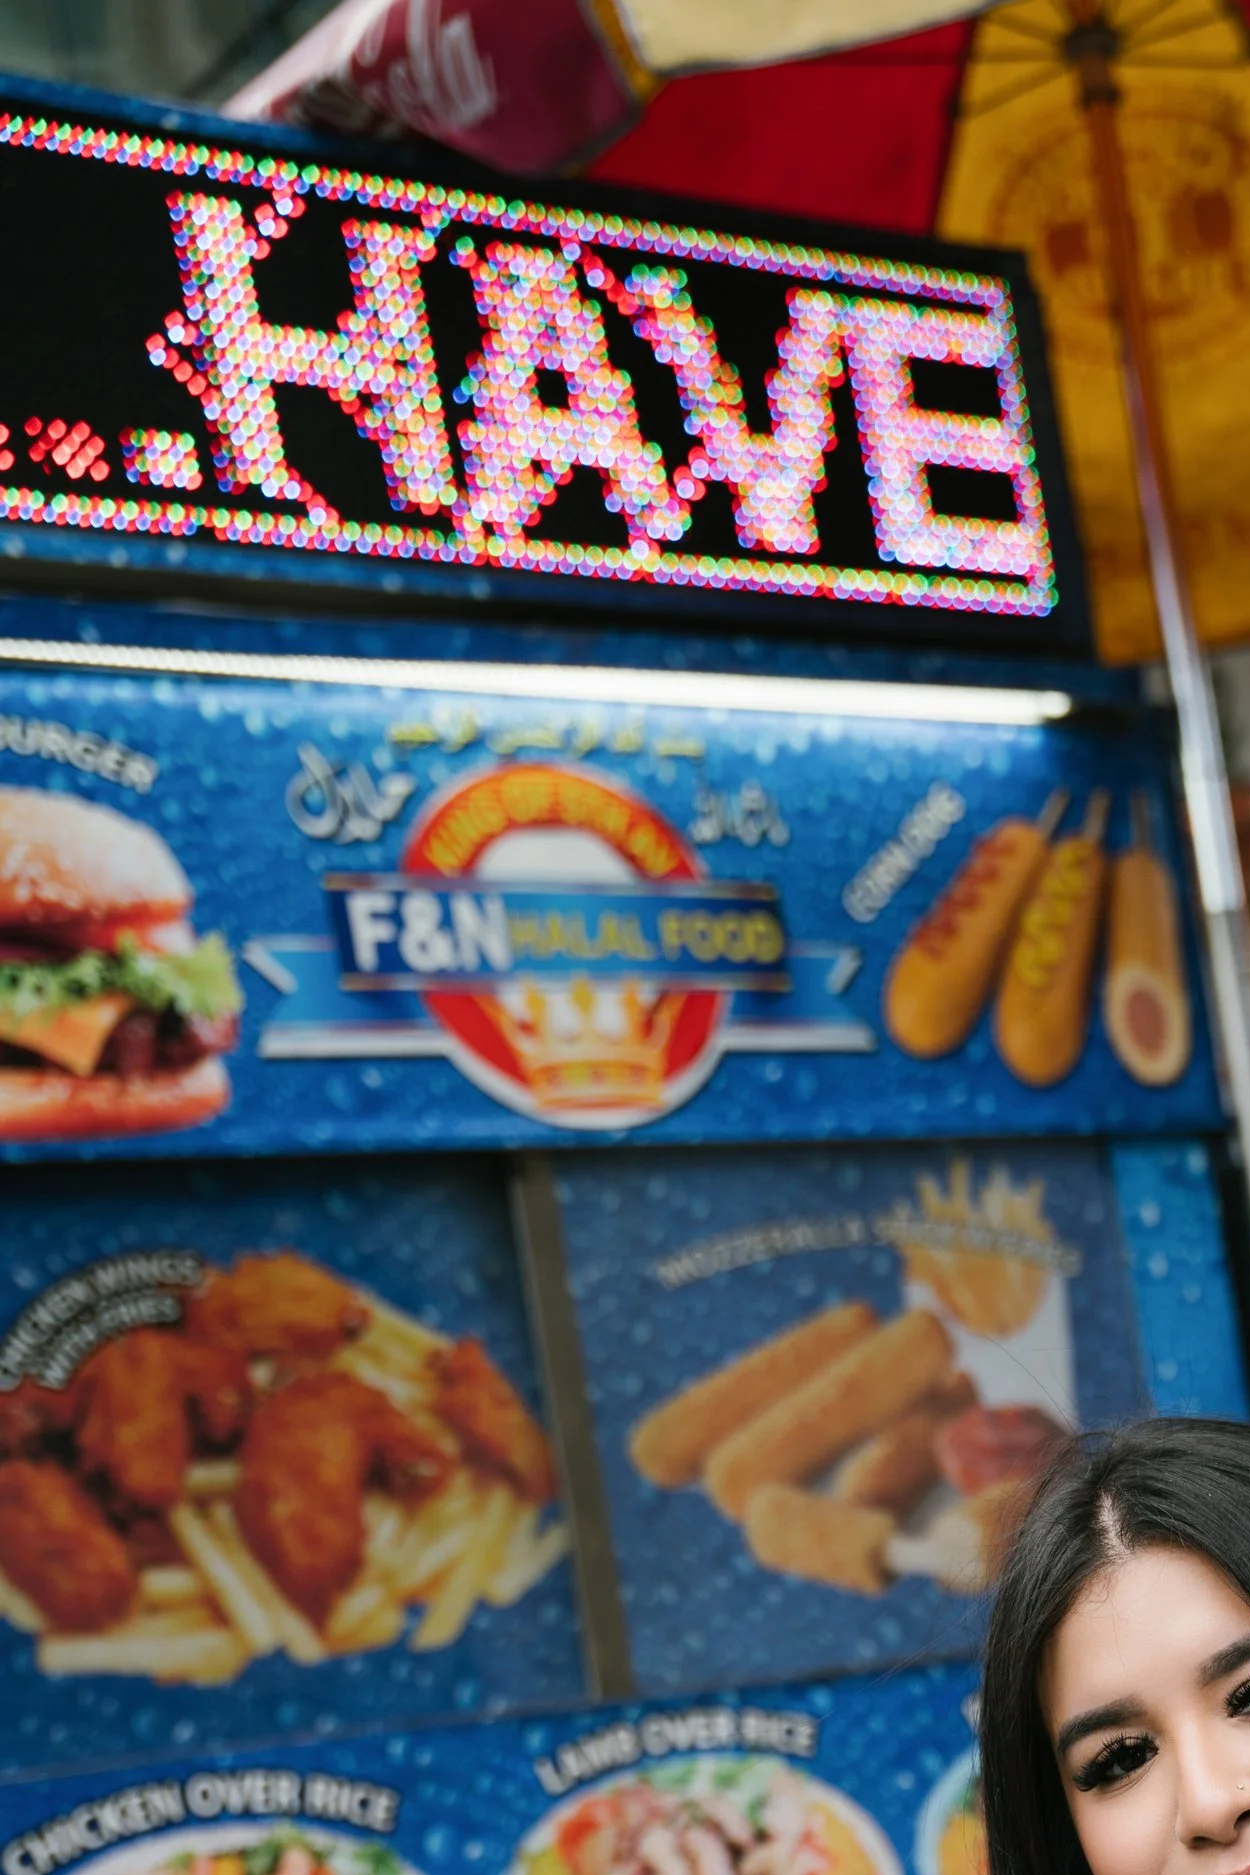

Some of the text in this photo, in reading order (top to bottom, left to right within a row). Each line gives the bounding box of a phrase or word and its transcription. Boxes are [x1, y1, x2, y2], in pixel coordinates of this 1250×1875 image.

[165, 192, 1040, 576] HAVE
[0, 712, 159, 795] URGER
[344, 890, 784, 973] F&N HALAL FOOD
[93, 1252, 204, 1292] WINGS
[533, 1704, 820, 1796] LAMB OVER RICE
[184, 1768, 301, 1819] OVER
[302, 1771, 401, 1834] RICE
